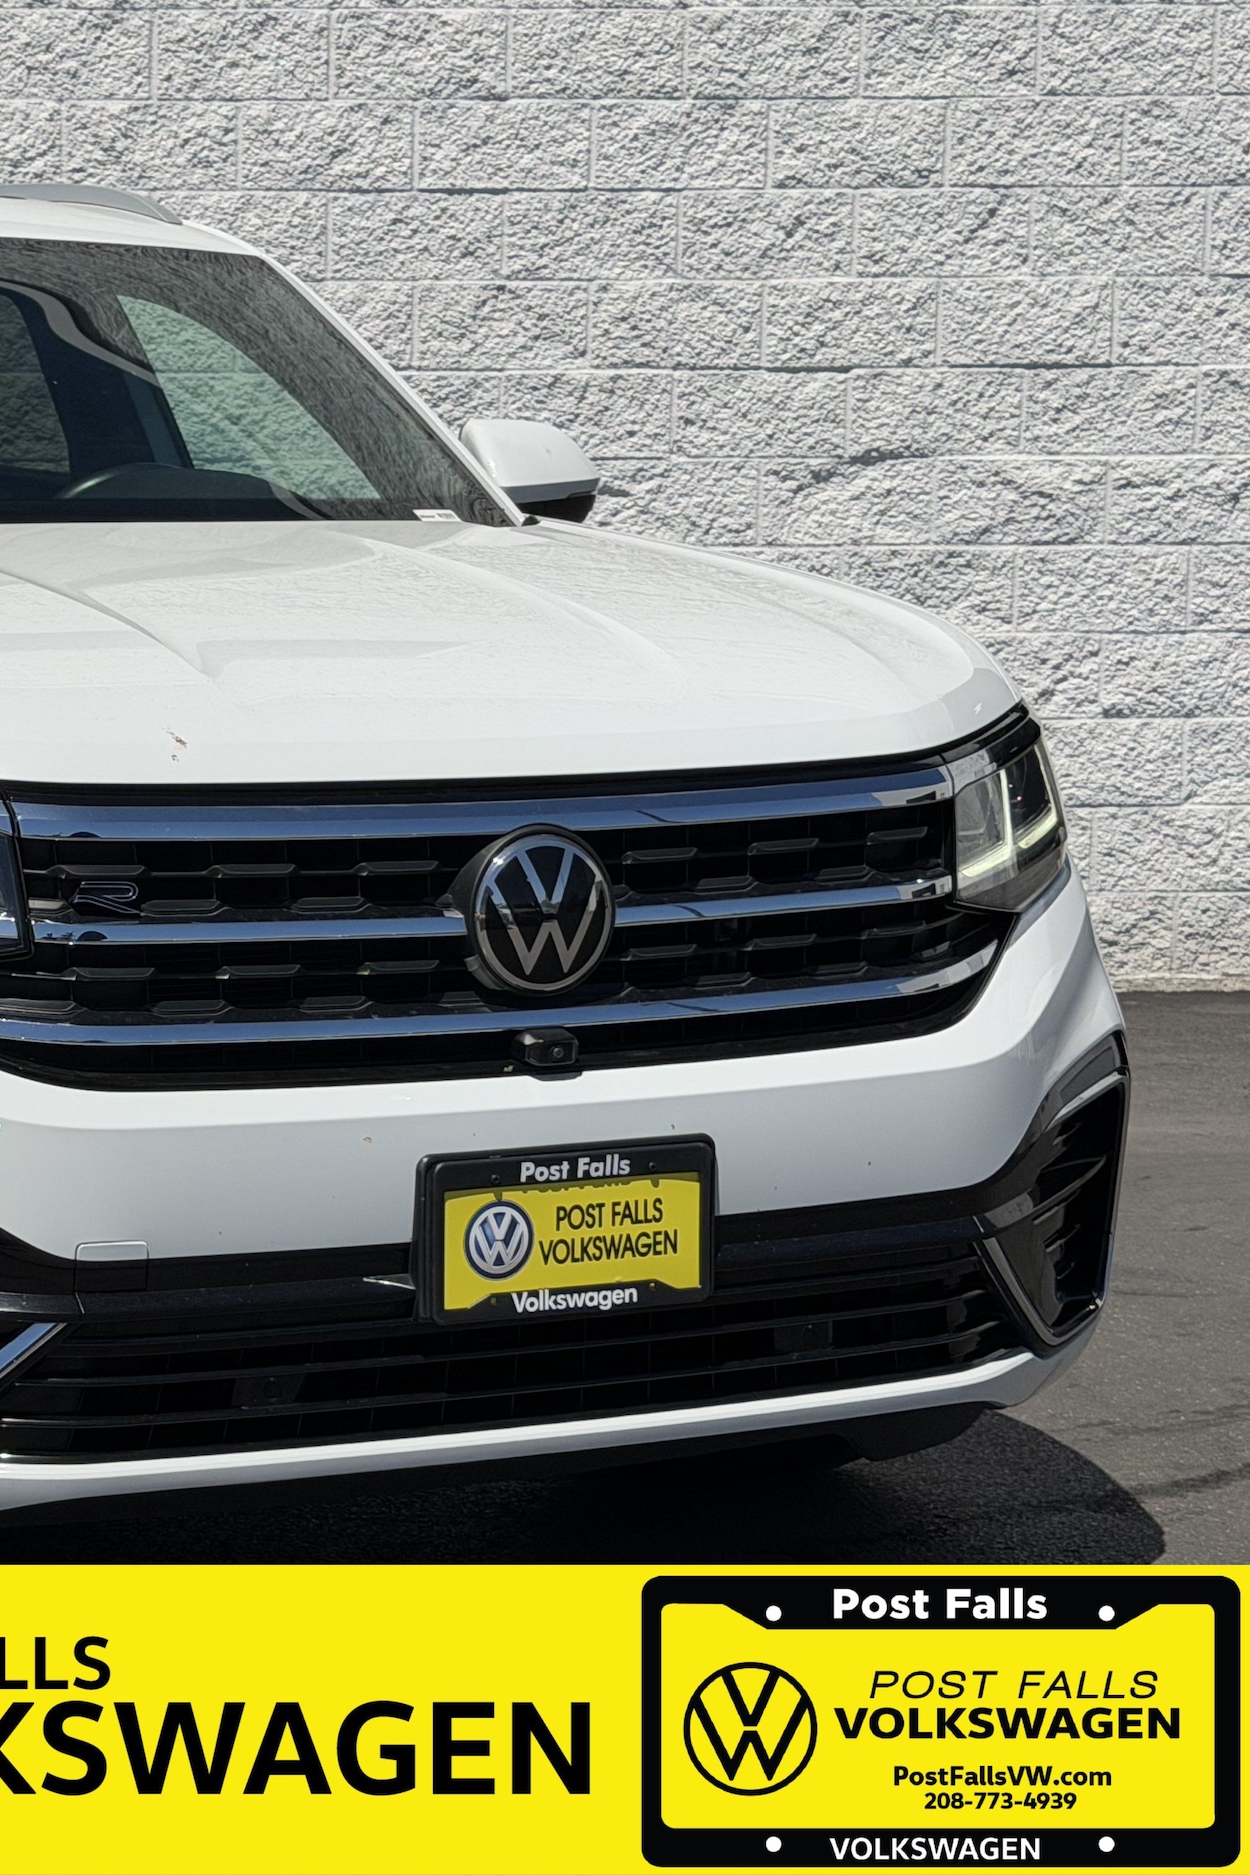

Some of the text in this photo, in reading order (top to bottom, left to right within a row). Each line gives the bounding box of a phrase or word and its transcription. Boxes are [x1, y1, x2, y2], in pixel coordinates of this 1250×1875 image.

[520, 1153, 630, 1182] Post Falls
[556, 1197, 663, 1231] POST FALLS
[539, 1229, 678, 1265] VOLKSWAGEN
[511, 1287, 638, 1313] Volkswagen
